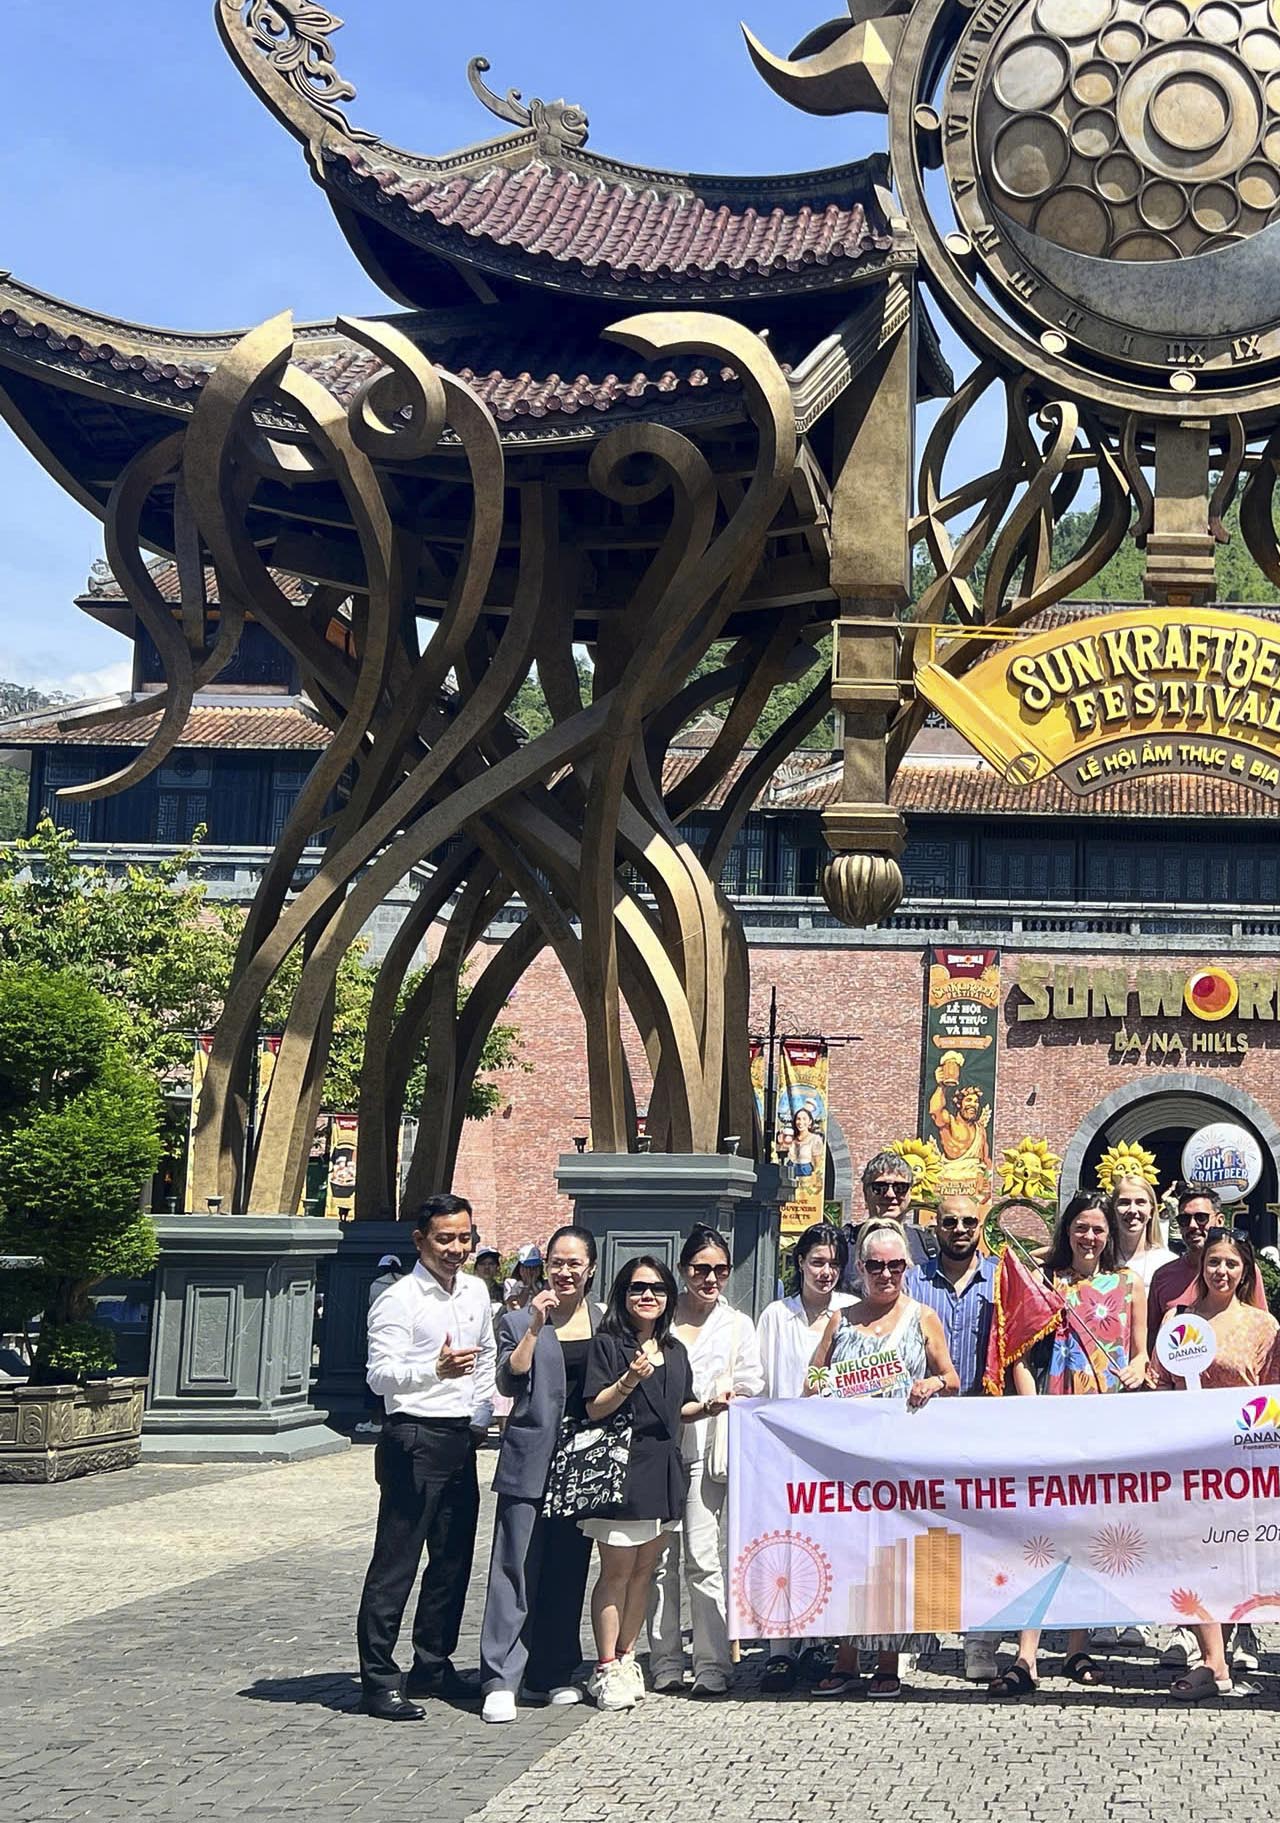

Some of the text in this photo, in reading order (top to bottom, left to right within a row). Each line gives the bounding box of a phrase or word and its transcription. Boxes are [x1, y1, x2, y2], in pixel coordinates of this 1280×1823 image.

[1012, 636, 1104, 710] SUN
[1077, 756, 1102, 782] LỄ
[1104, 748, 1137, 772] HỘI
[1178, 745, 1227, 766] THỰC
[1231, 753, 1245, 771] &
[1250, 759, 1280, 785] BIA
[1192, 1032, 1249, 1053] HILLS
[1195, 1154, 1221, 1170] SUN
[1191, 1168, 1248, 1182] KRAFTBEER
[835, 1349, 898, 1375] WELCOME
[1168, 1345, 1208, 1361] DANANG
[835, 1360, 903, 1389] EMIRATES
[786, 1479, 946, 1514] WELCOME
[954, 1477, 1017, 1510] THE
[1027, 1469, 1172, 1508] FAMTRIP
[1183, 1465, 1280, 1501] FROM
[1202, 1526, 1249, 1544] June
